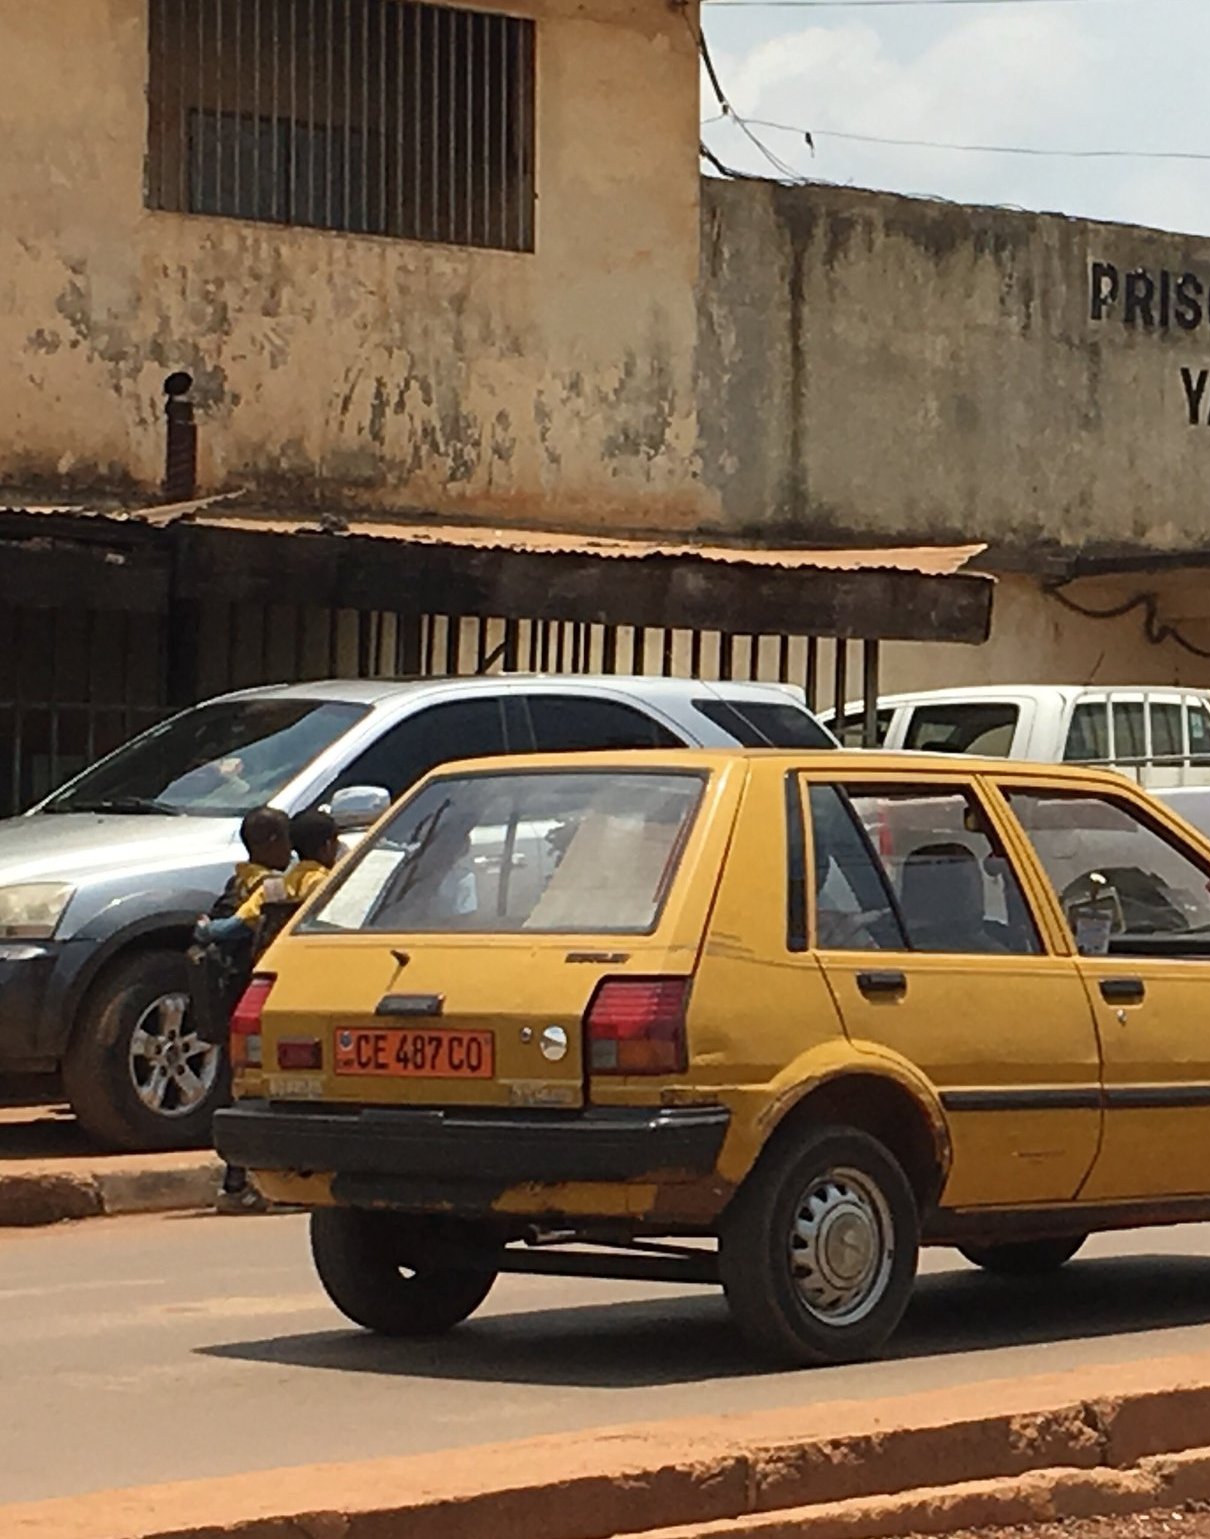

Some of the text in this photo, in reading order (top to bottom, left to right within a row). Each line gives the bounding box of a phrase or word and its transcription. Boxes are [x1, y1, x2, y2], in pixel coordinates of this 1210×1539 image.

[356, 1033, 483, 1072] CE 487 CO
